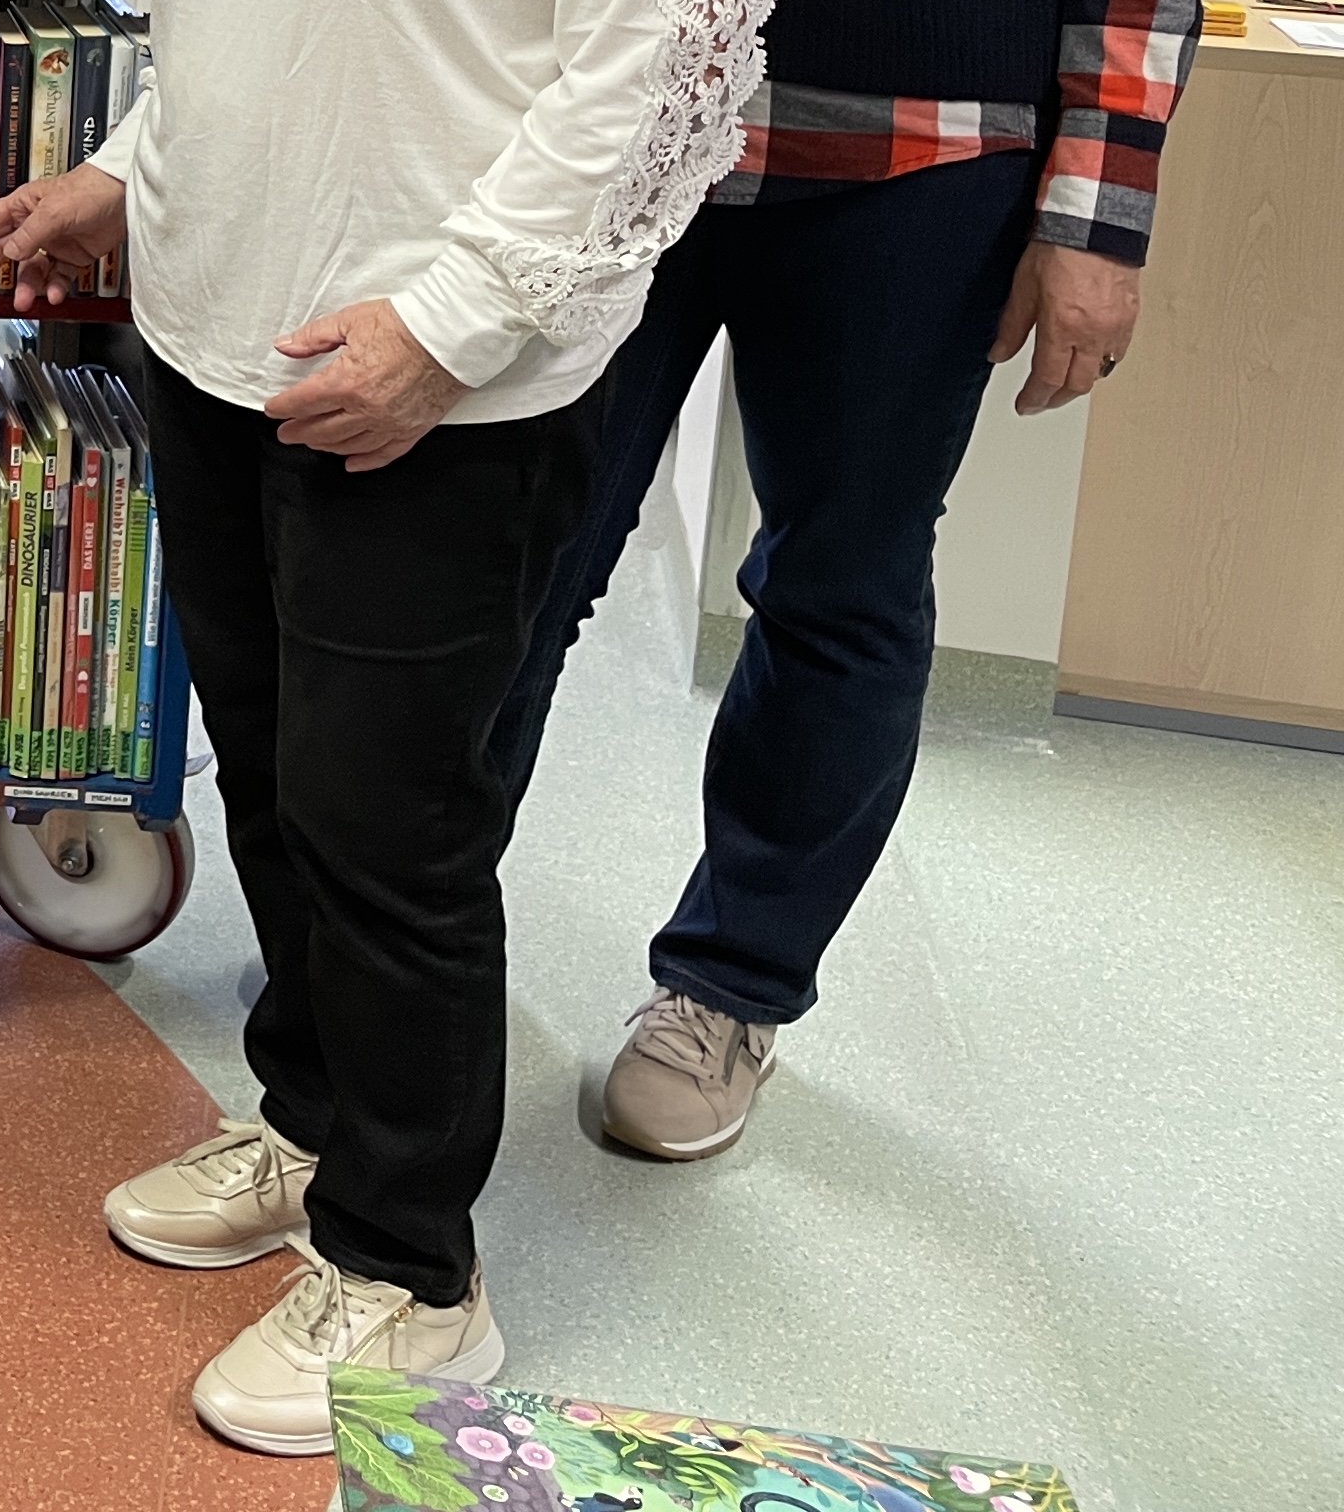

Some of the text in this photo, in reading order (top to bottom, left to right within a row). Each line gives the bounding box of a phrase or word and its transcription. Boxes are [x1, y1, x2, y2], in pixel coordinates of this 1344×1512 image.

[21, 492, 37, 587] DINOSAURIER
[107, 477, 126, 646] Weshalb? Deshalb! Körper
[126, 607, 138, 643] Körper
